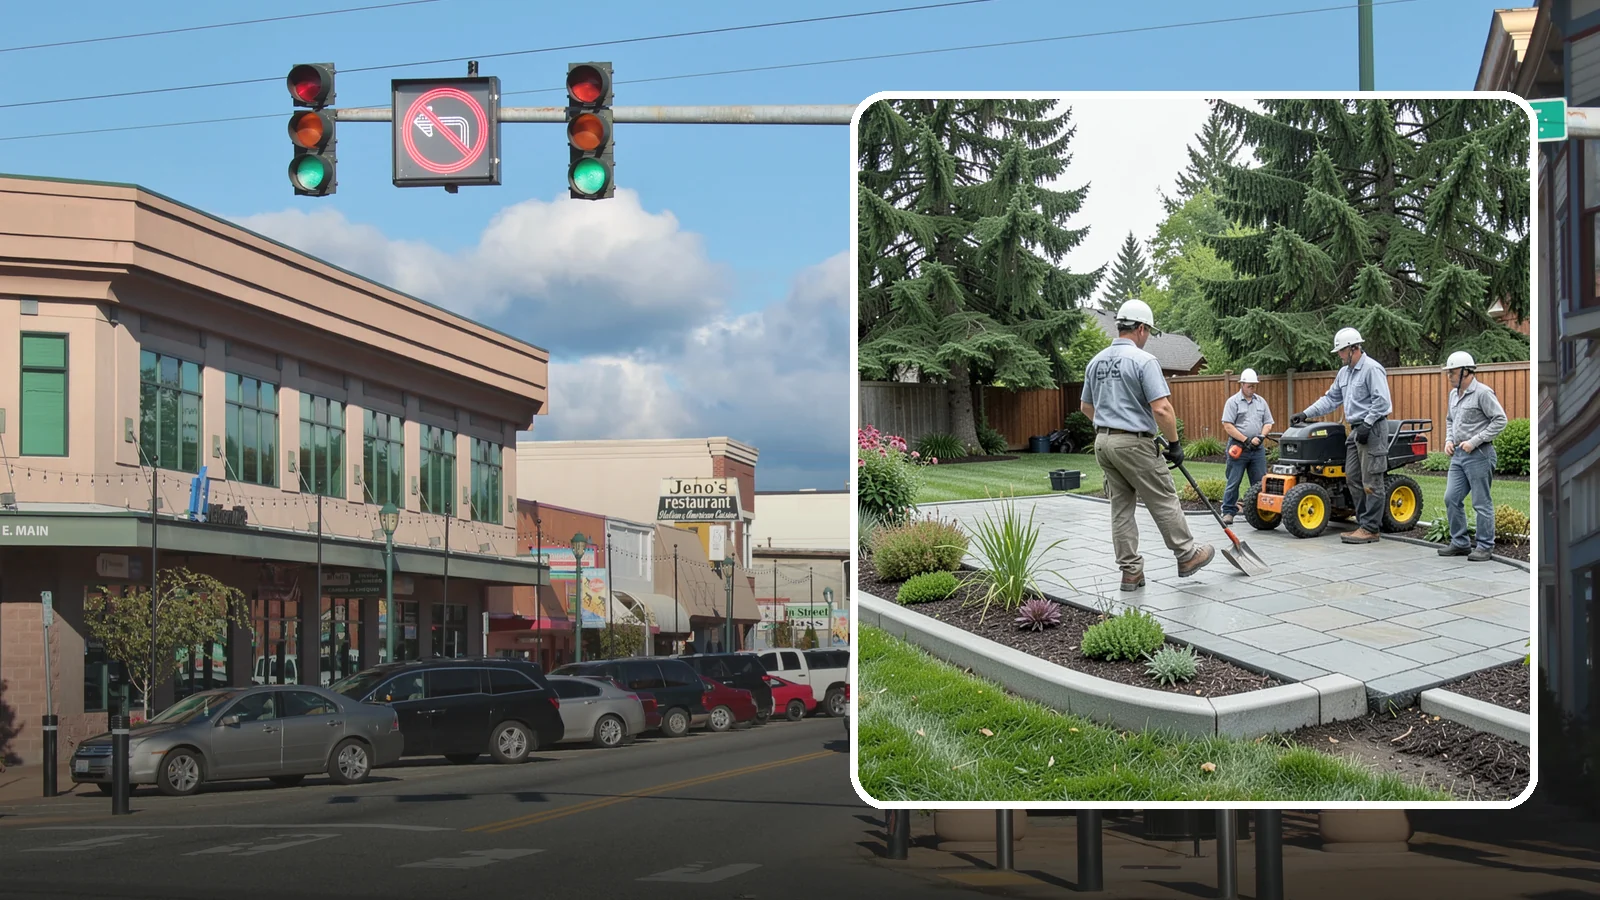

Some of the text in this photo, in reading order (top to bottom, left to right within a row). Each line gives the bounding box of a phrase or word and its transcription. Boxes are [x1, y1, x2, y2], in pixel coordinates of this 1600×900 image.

[670, 480, 728, 494] Jeno's
[665, 496, 731, 509] restaurant
[686, 509, 715, 519] American
[715, 509, 738, 519] Cuisine
[2, 525, 49, 536] E. MAIN
[797, 607, 828, 616] Street
